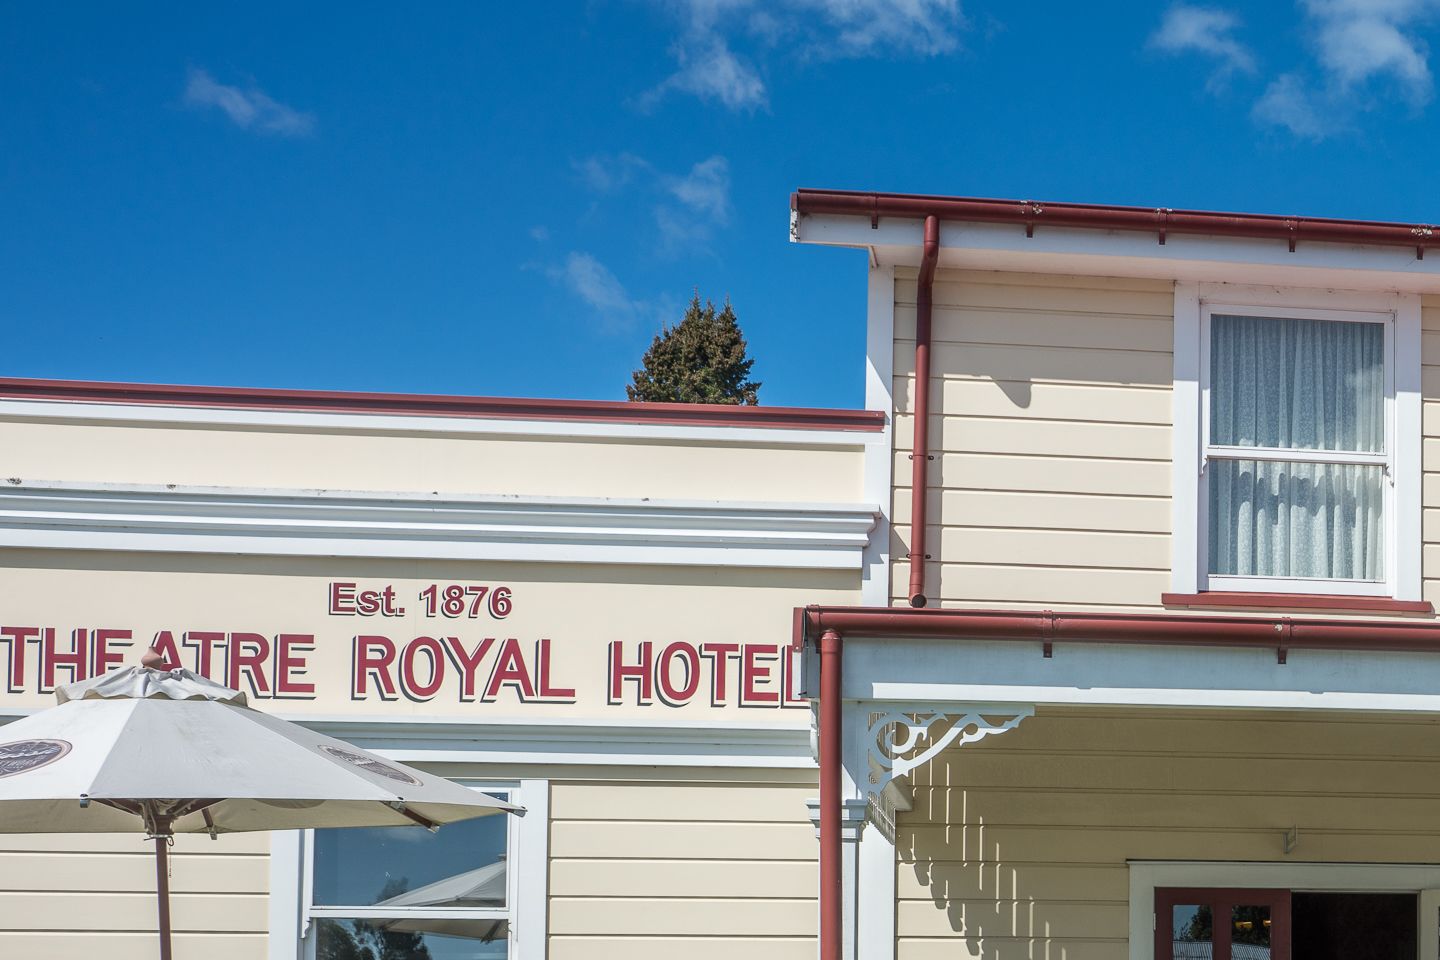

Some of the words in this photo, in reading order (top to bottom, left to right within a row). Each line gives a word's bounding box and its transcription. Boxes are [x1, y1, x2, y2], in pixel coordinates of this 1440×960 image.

[328, 582, 405, 616] Est.
[419, 584, 513, 619] 1876
[351, 635, 577, 703] ROYAL
